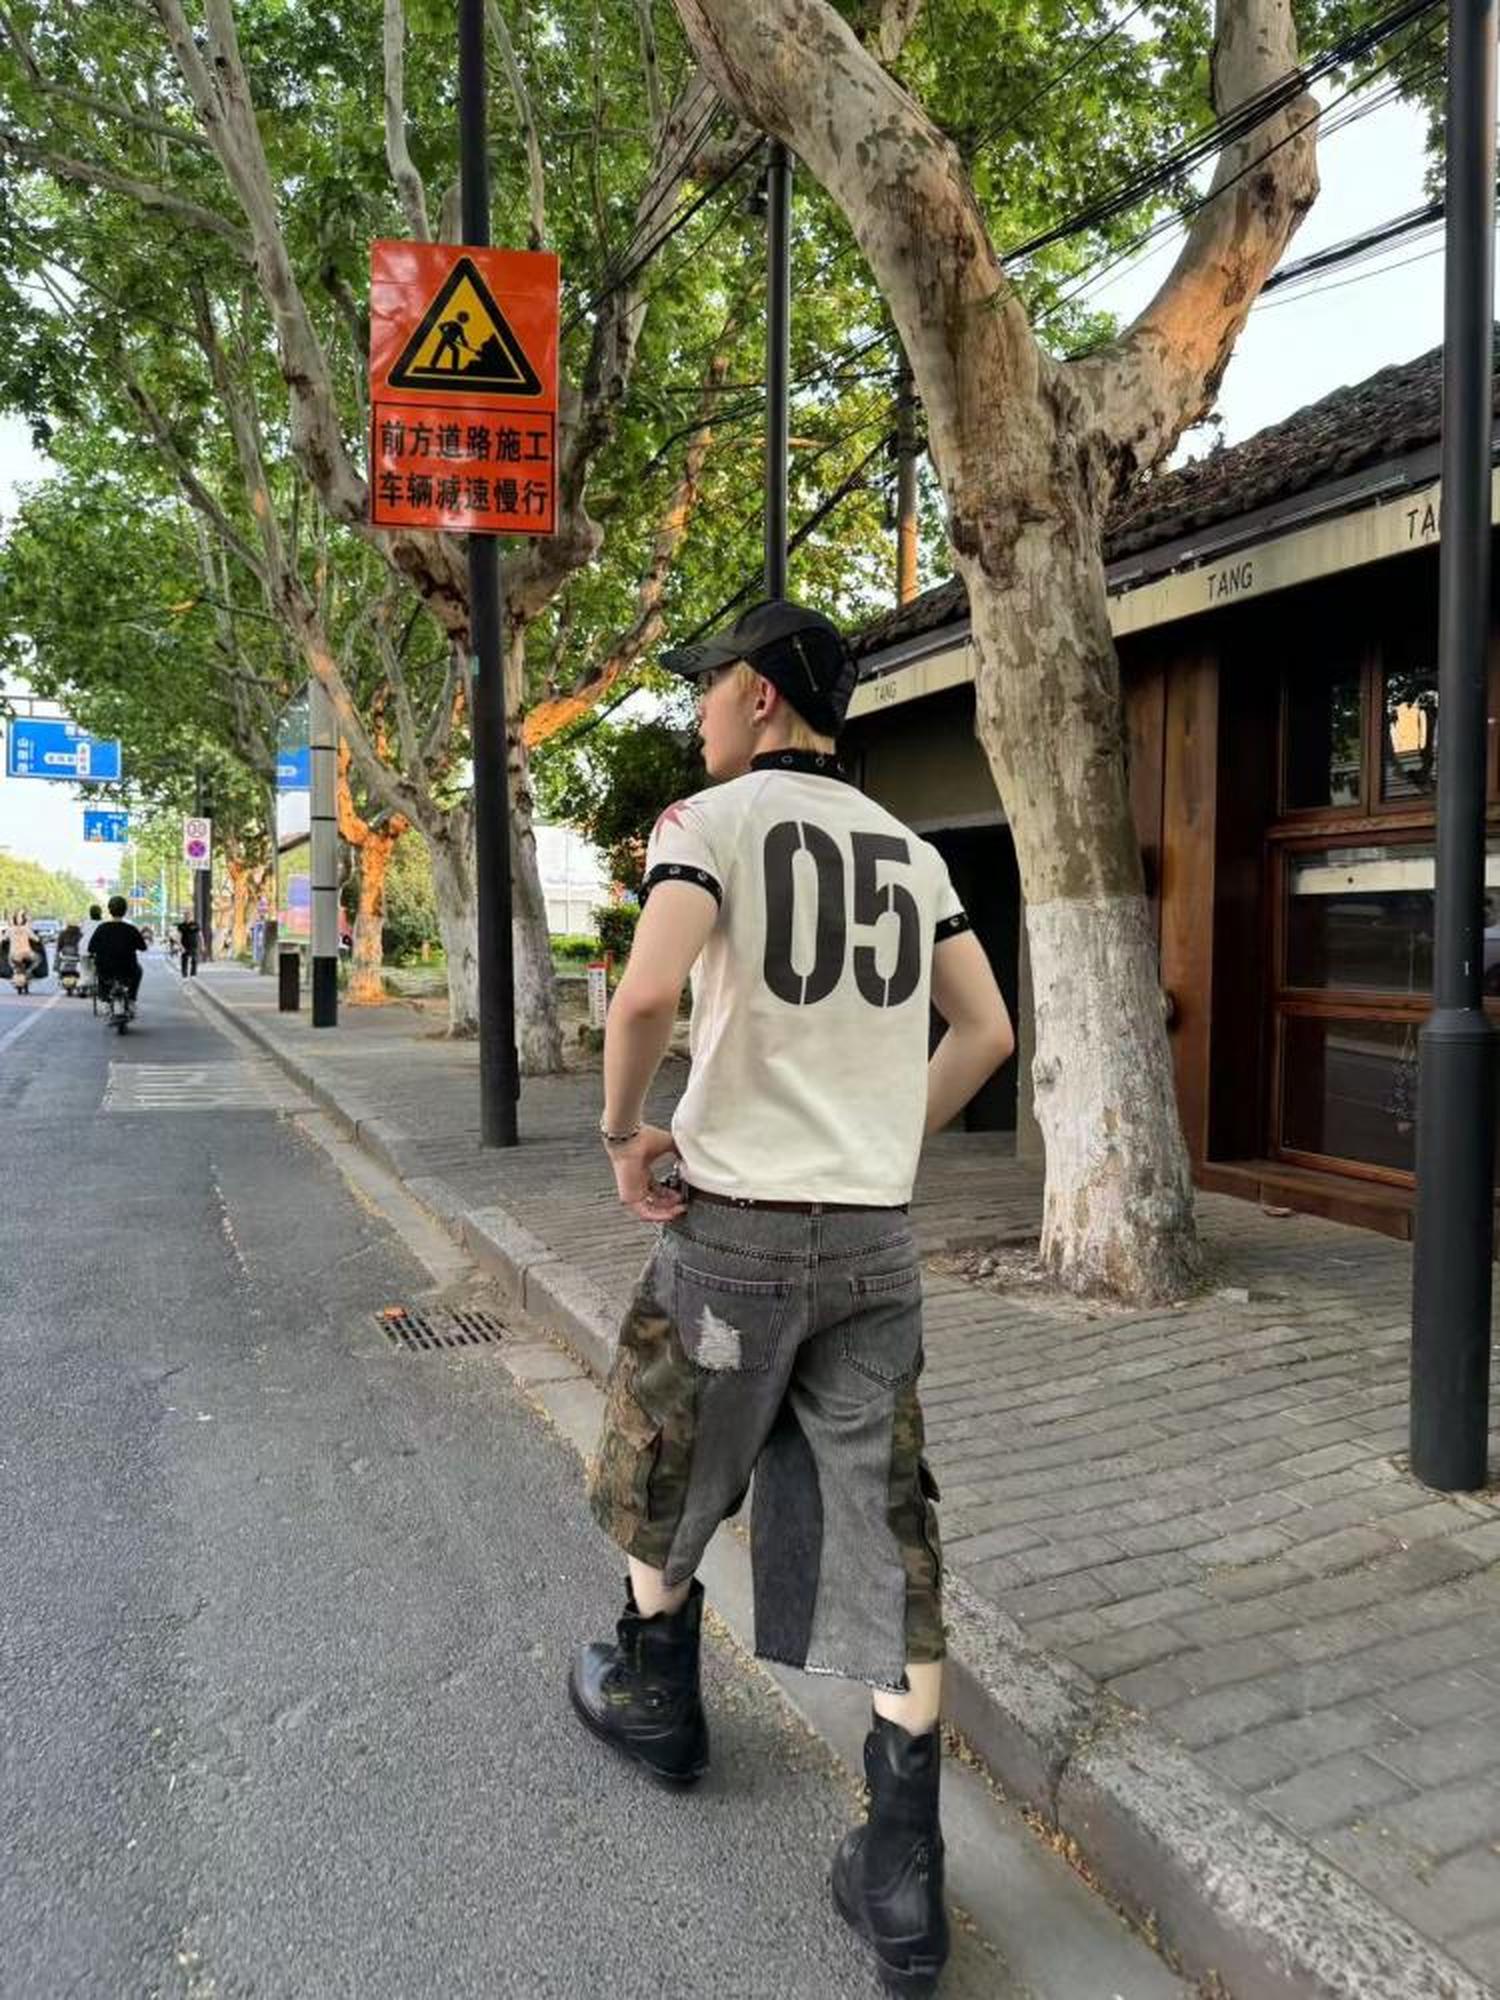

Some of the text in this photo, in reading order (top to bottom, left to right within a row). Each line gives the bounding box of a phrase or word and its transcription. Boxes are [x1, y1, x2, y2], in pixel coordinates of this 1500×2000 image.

[380, 419, 548, 462] 前方道路施工
[379, 470, 548, 515] 车辆减速慢行
[1407, 503, 1440, 541] TA
[1206, 561, 1254, 600] TANG
[763, 820, 921, 1008] 05
